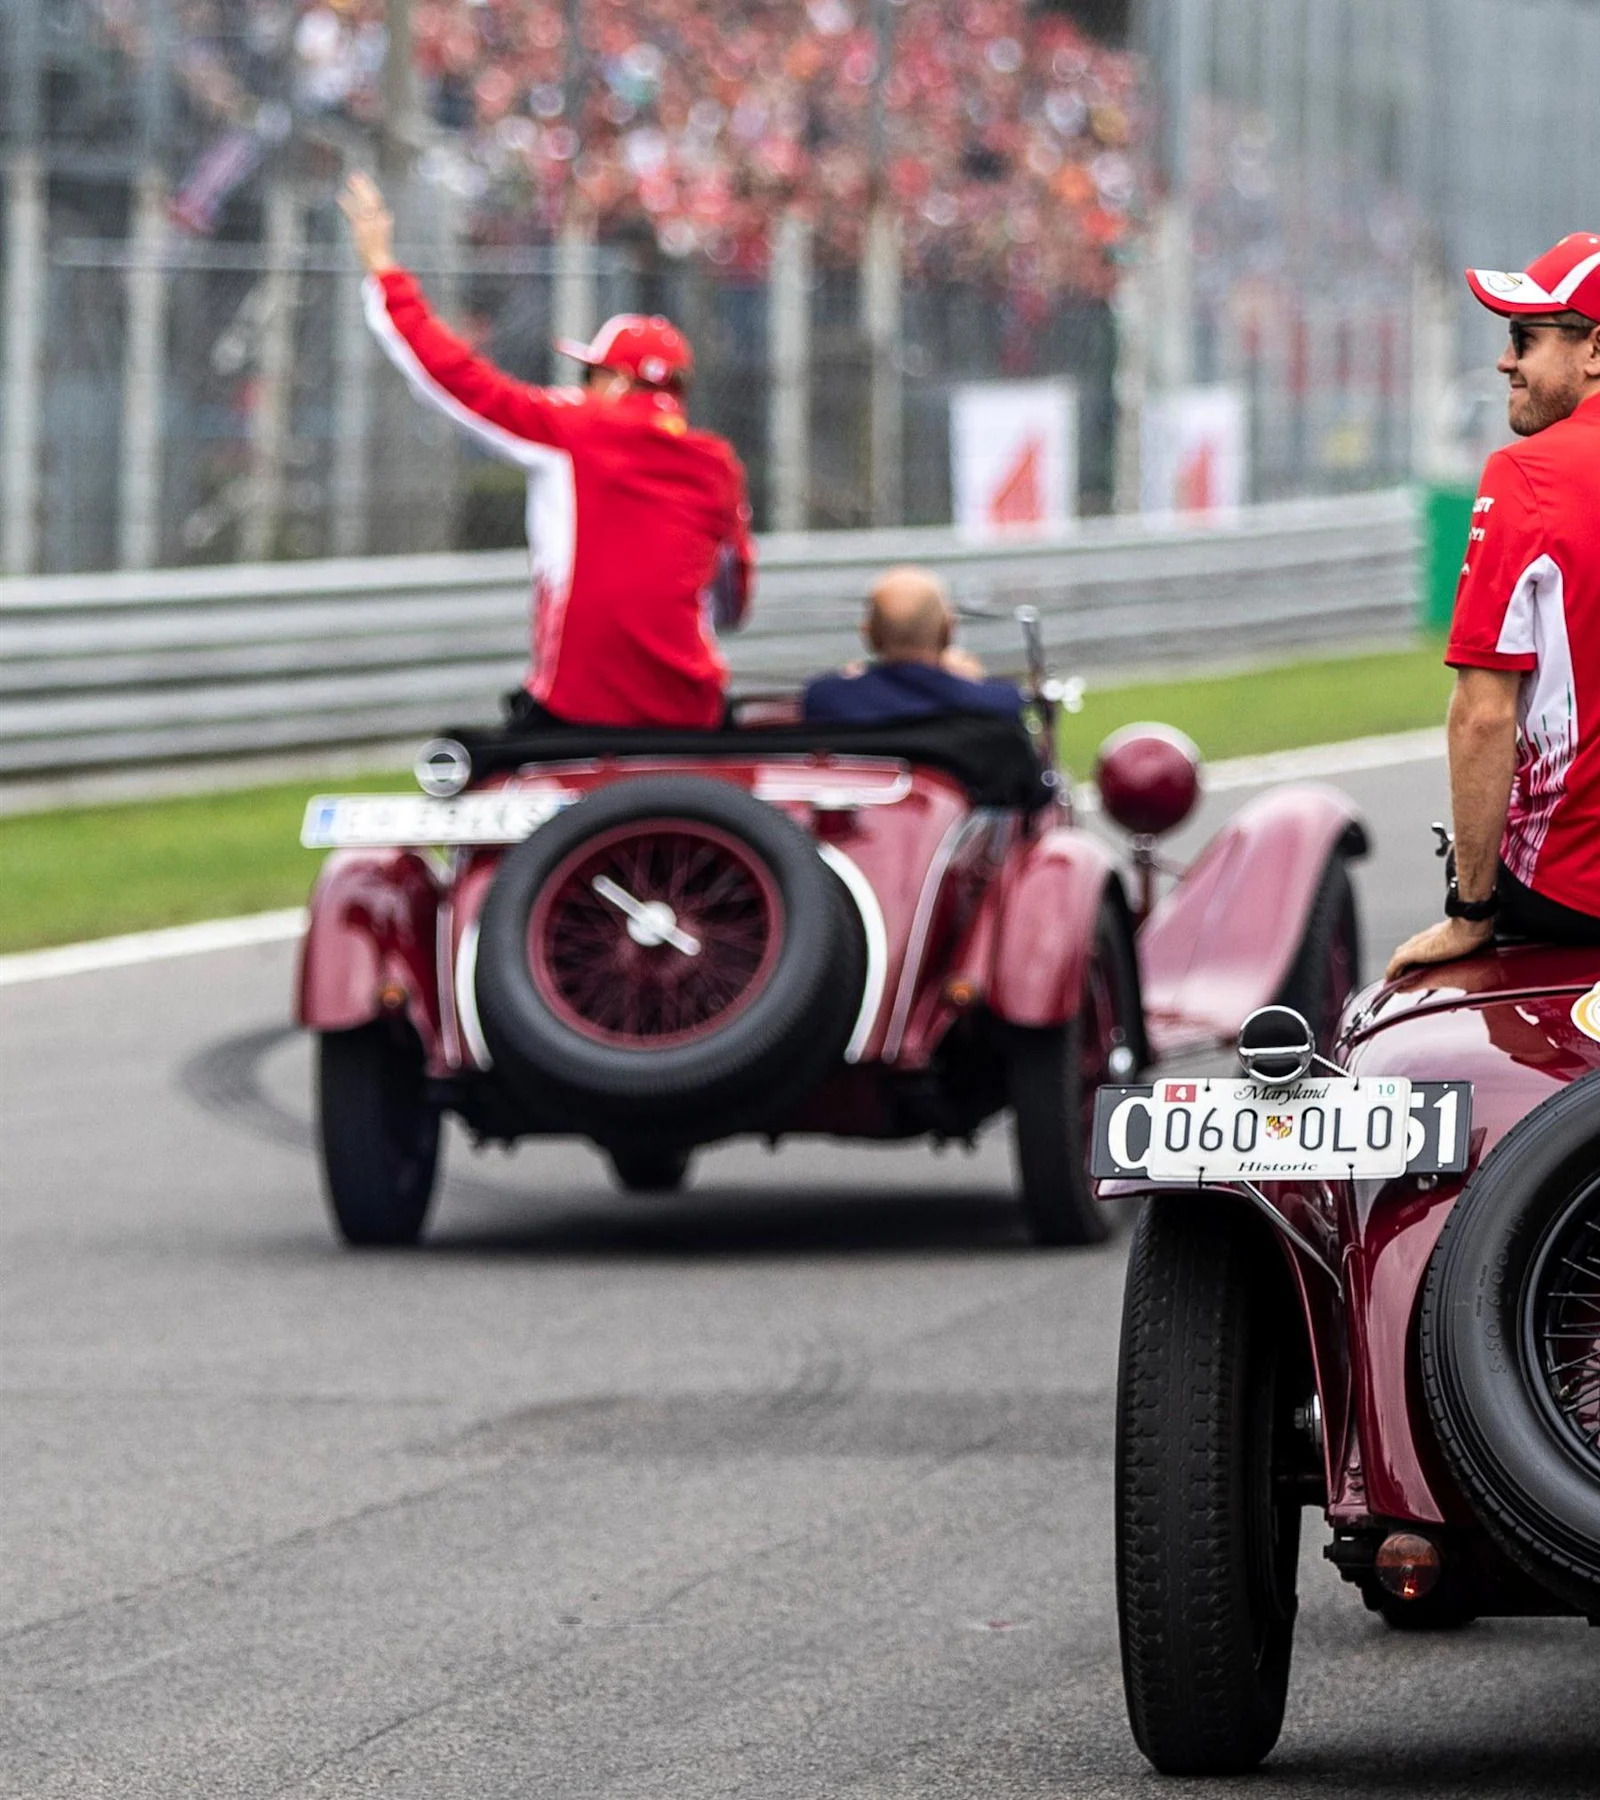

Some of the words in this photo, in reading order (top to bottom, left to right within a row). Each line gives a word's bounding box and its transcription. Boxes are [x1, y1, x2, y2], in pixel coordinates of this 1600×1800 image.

[1234, 1083, 1330, 1106] Maryland
[1378, 1083, 1396, 1096] 10
[1165, 1107, 1258, 1153] 060
[1238, 1161, 1318, 1172] Historic
